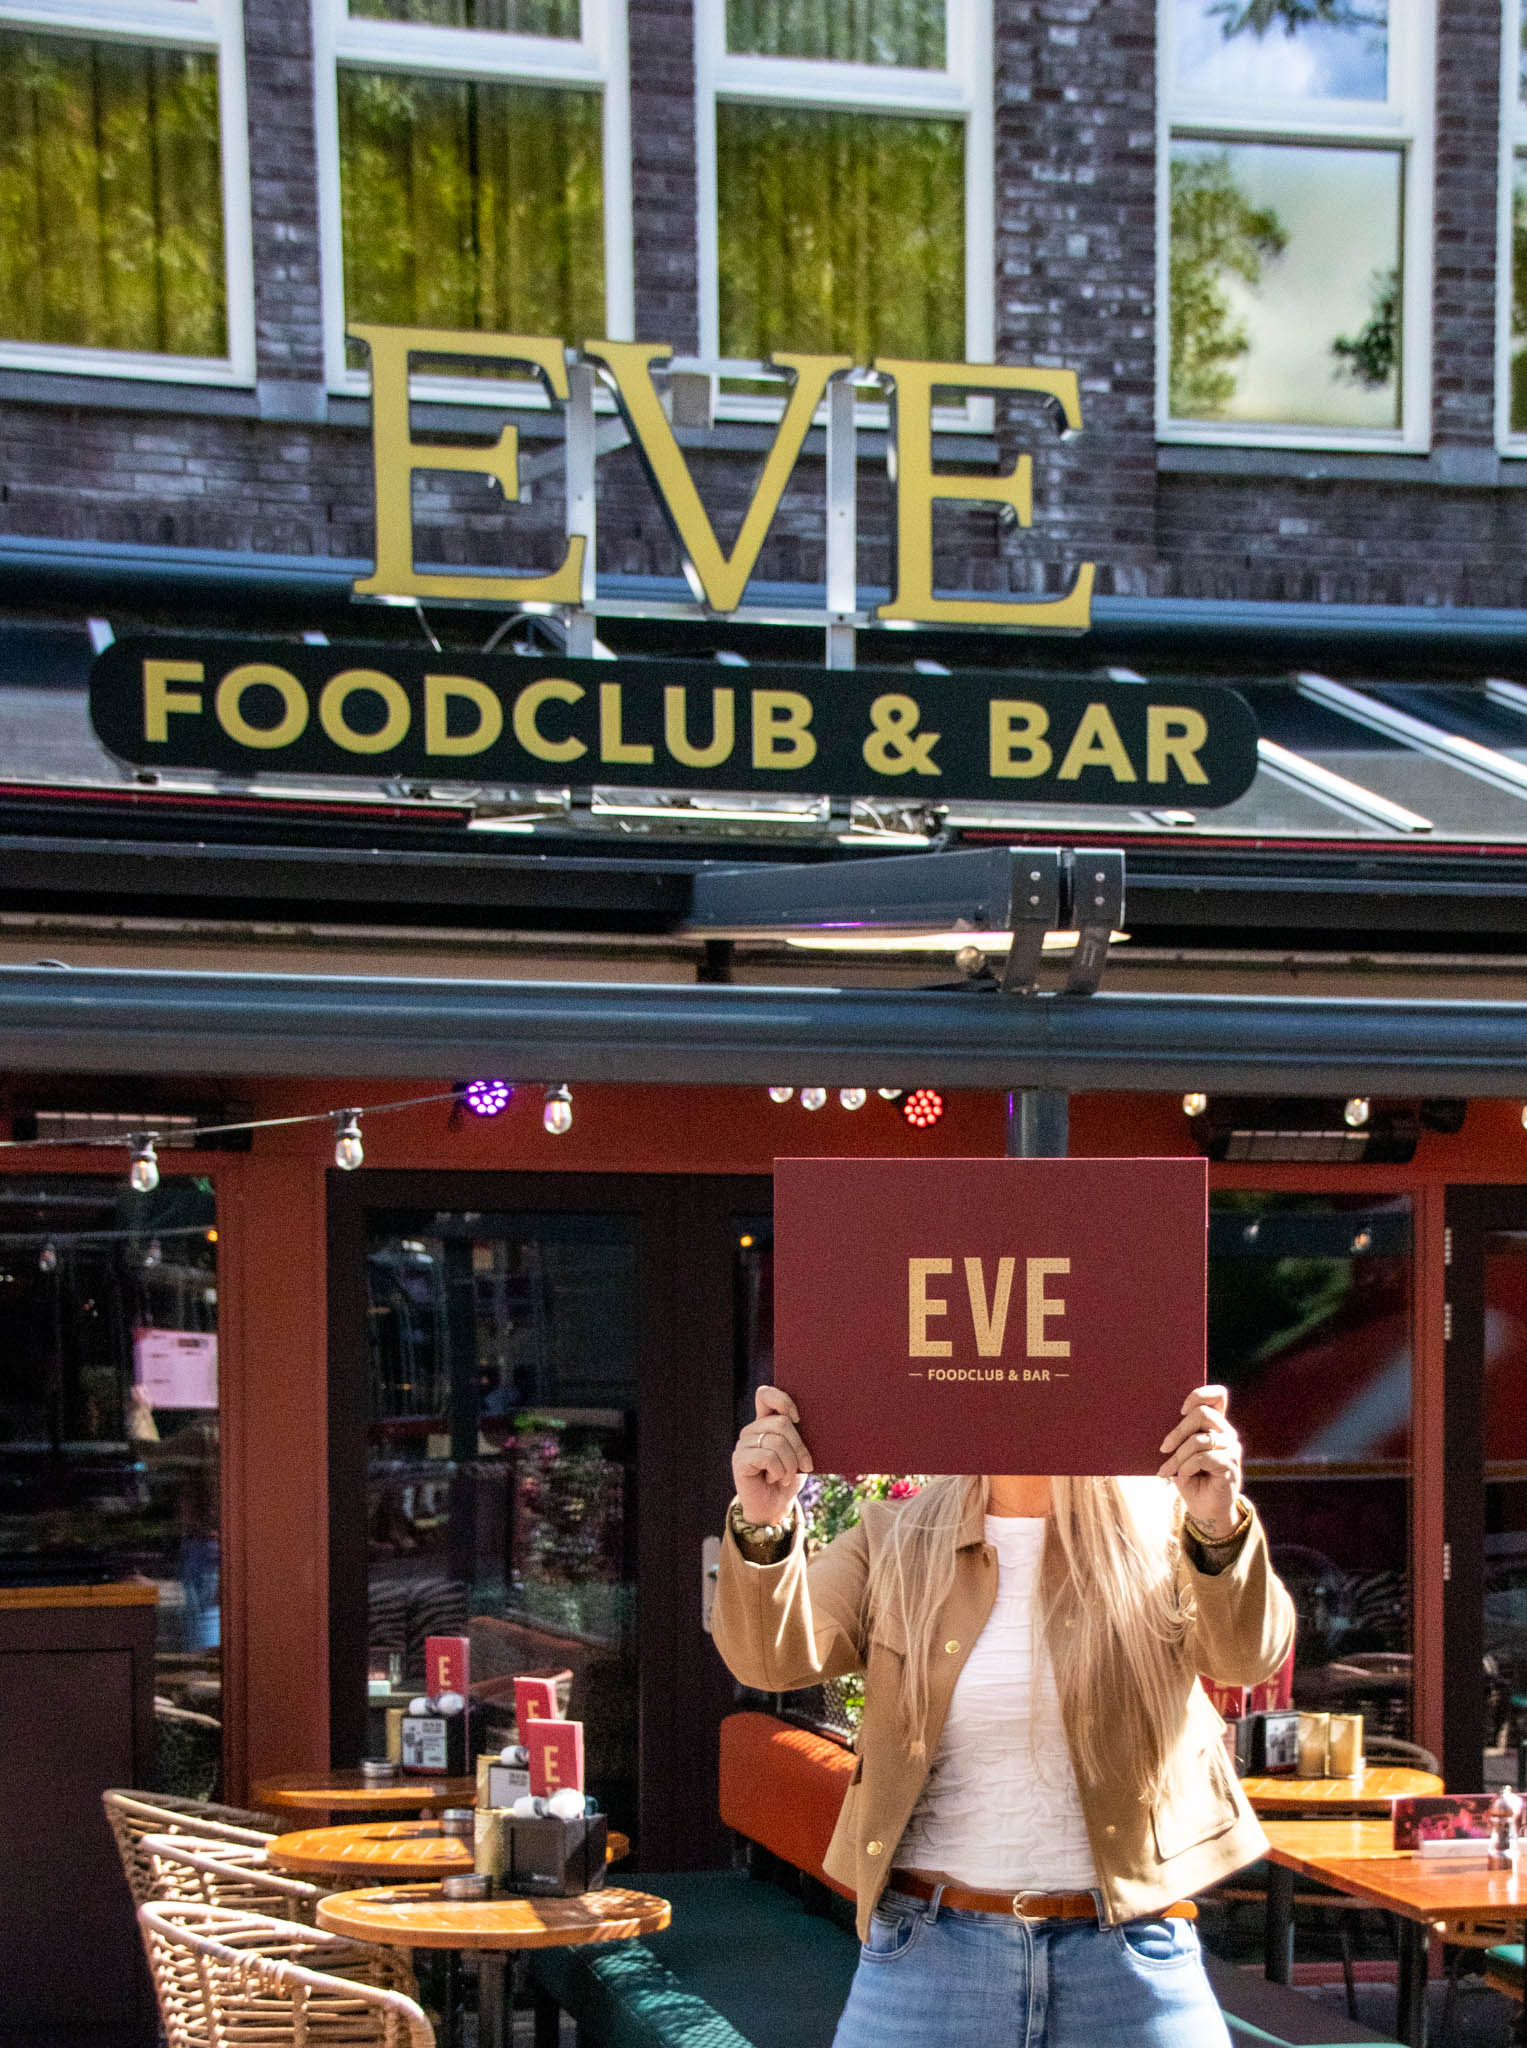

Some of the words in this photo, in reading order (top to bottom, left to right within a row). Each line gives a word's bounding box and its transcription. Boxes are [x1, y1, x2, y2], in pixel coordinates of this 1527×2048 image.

[347, 322, 1096, 629] EVE
[143, 660, 817, 770] FOODCLUB
[862, 694, 941, 776] &
[990, 700, 1210, 784] BAR
[908, 1256, 1071, 1358] EVE
[927, 1368, 1005, 1382] FOODCLUB
[1007, 1369, 1019, 1382] &
[1022, 1368, 1051, 1382] BAR
[438, 1655, 452, 1692] E
[543, 1745, 561, 1795] E
